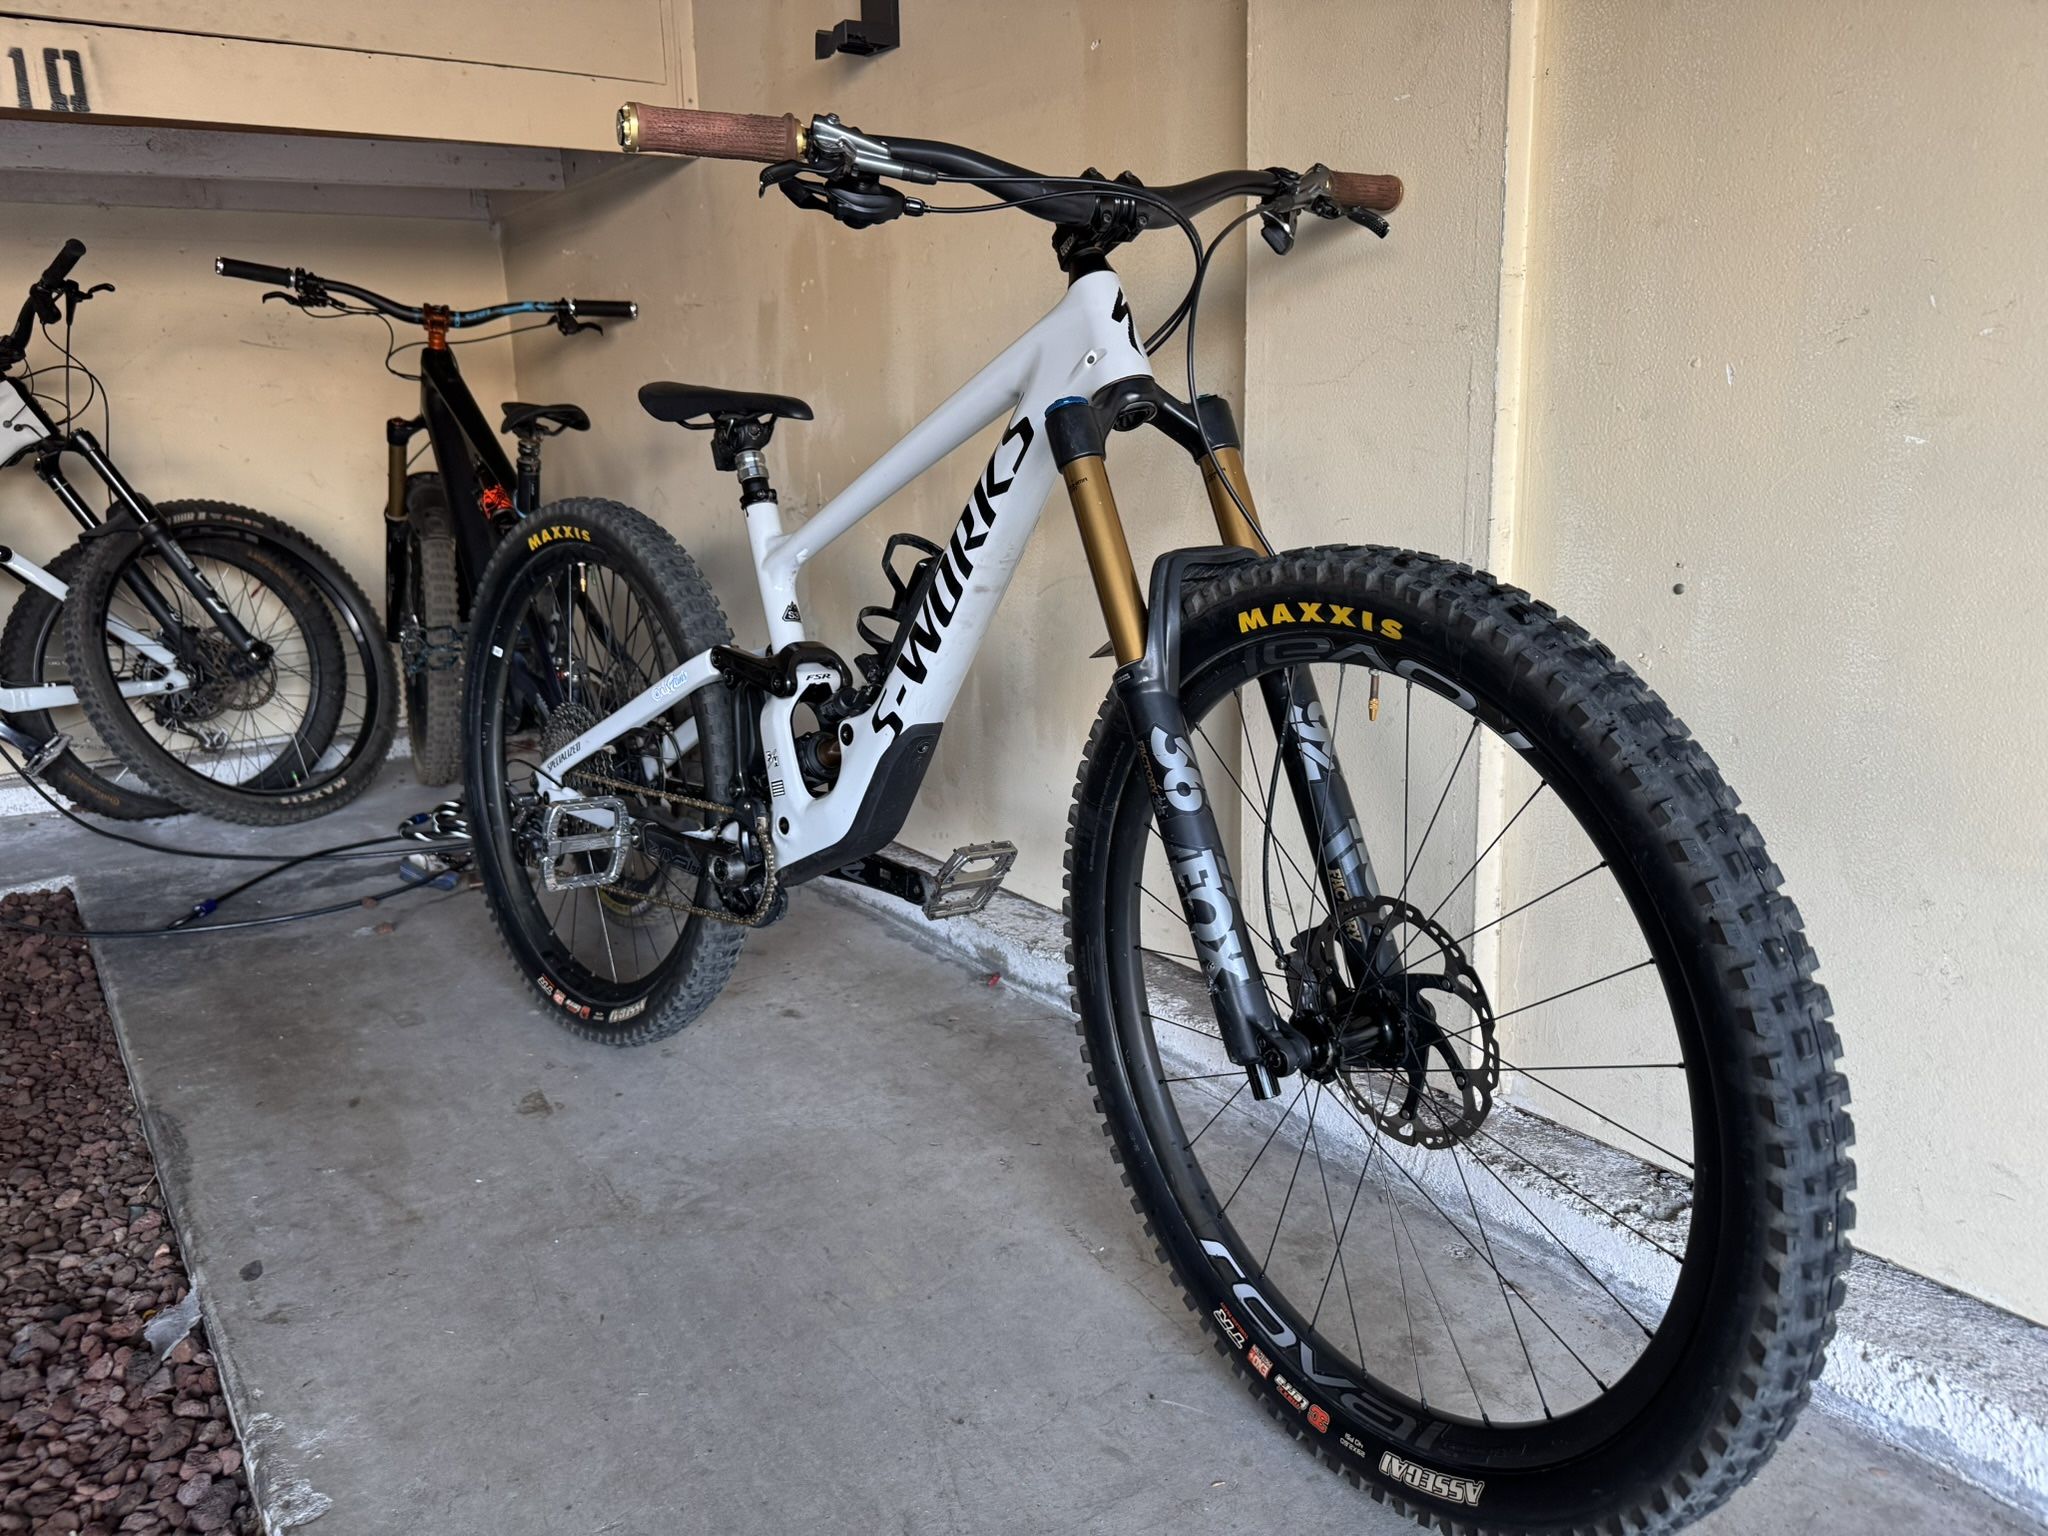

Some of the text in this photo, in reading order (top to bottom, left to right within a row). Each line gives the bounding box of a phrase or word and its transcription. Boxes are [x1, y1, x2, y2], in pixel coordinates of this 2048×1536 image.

[7, 47, 91, 112] 10
[528, 526, 591, 551] MAXXIS
[1238, 602, 1403, 640] MAXXIS
[806, 673, 831, 681] FSR
[547, 741, 581, 771] SPECIALIZED
[1137, 740, 1159, 795] FACTORY
[1151, 726, 1204, 812] 36
[1170, 848, 1250, 983] FOX
[1328, 868, 1363, 943] FACRY
[1213, 1308, 1245, 1350] TR
[1379, 1451, 1485, 1506] ASSEGAI
